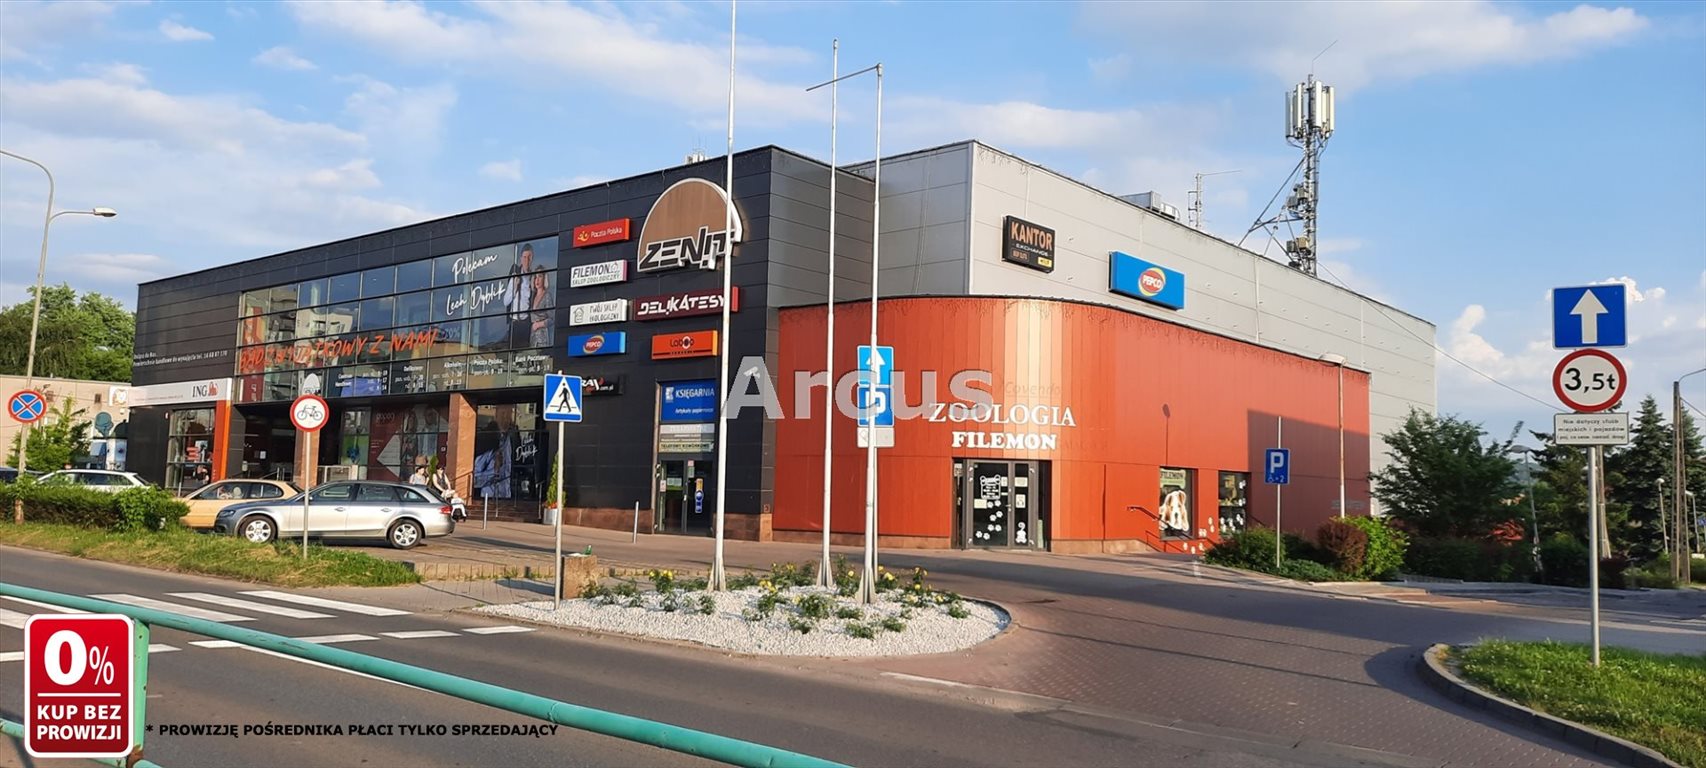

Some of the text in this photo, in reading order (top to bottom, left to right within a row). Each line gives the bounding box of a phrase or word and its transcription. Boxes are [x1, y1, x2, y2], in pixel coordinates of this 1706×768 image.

[590, 227, 622, 238] Poczta Polska
[1011, 221, 1053, 251] KANTOR
[637, 226, 736, 272] ZENIT
[452, 254, 498, 284] Polecam
[572, 264, 610, 279] FILEMON
[1142, 273, 1163, 289] PEPCO
[446, 280, 506, 316] Lech Dyblik
[637, 294, 726, 316] DELIKATESY
[369, 334, 385, 354] Z
[585, 339, 602, 348] PEPCO
[1564, 367, 1616, 393] 3,5t
[192, 384, 208, 398] ING
[675, 388, 715, 399] KSIĘGARNIA
[928, 402, 1076, 427] ZOOLOGIA
[951, 431, 1057, 450] FILEMON
[1270, 452, 1284, 473] P
